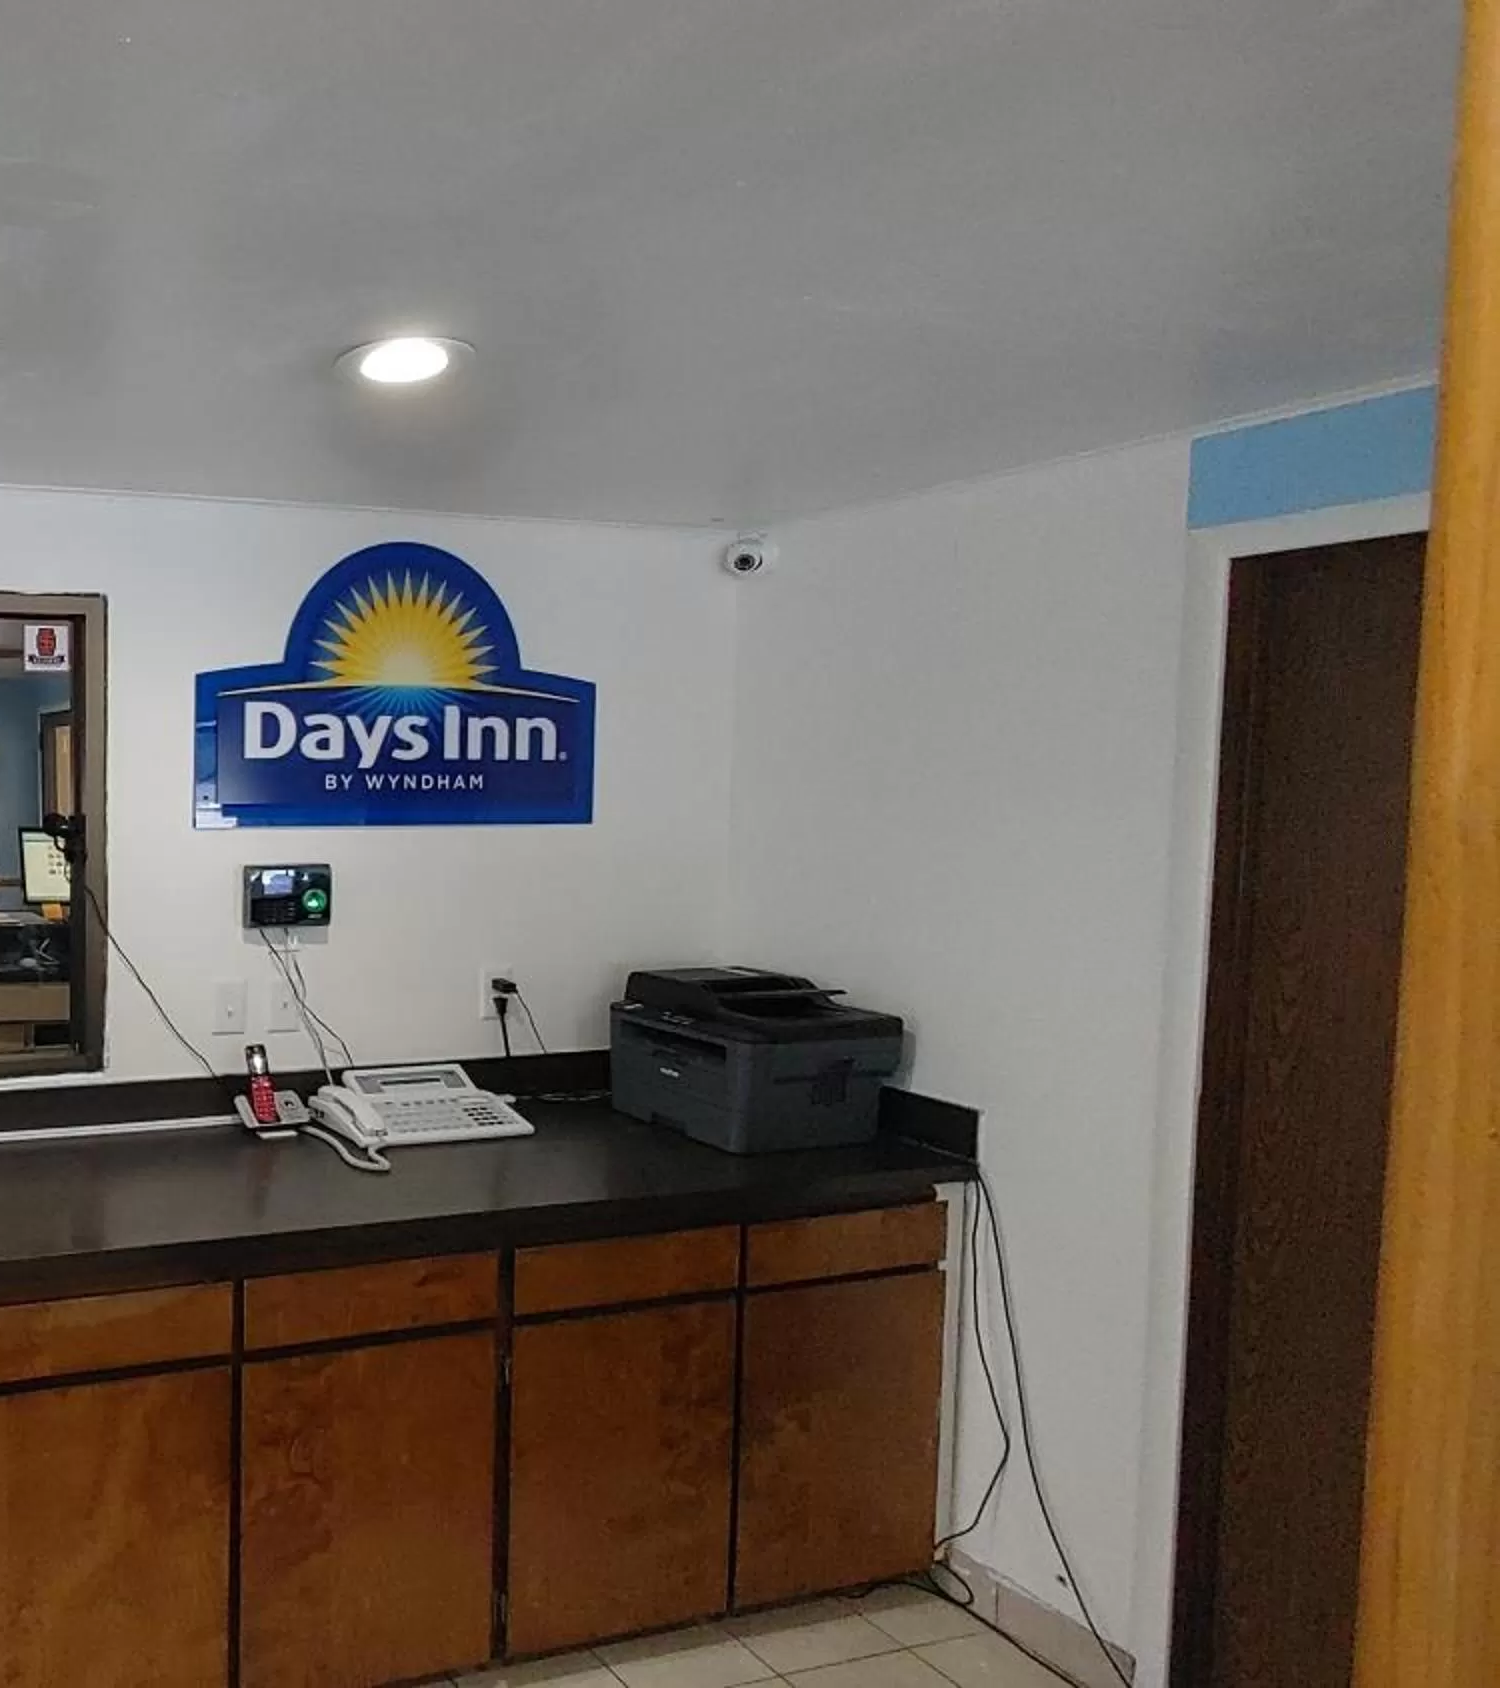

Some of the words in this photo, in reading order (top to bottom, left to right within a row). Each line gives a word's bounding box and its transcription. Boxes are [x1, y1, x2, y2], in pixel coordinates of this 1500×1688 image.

[243, 701, 430, 769] Days
[443, 705, 558, 761] Inn
[324, 774, 352, 790] BY
[366, 774, 485, 790] WYNDHAM
